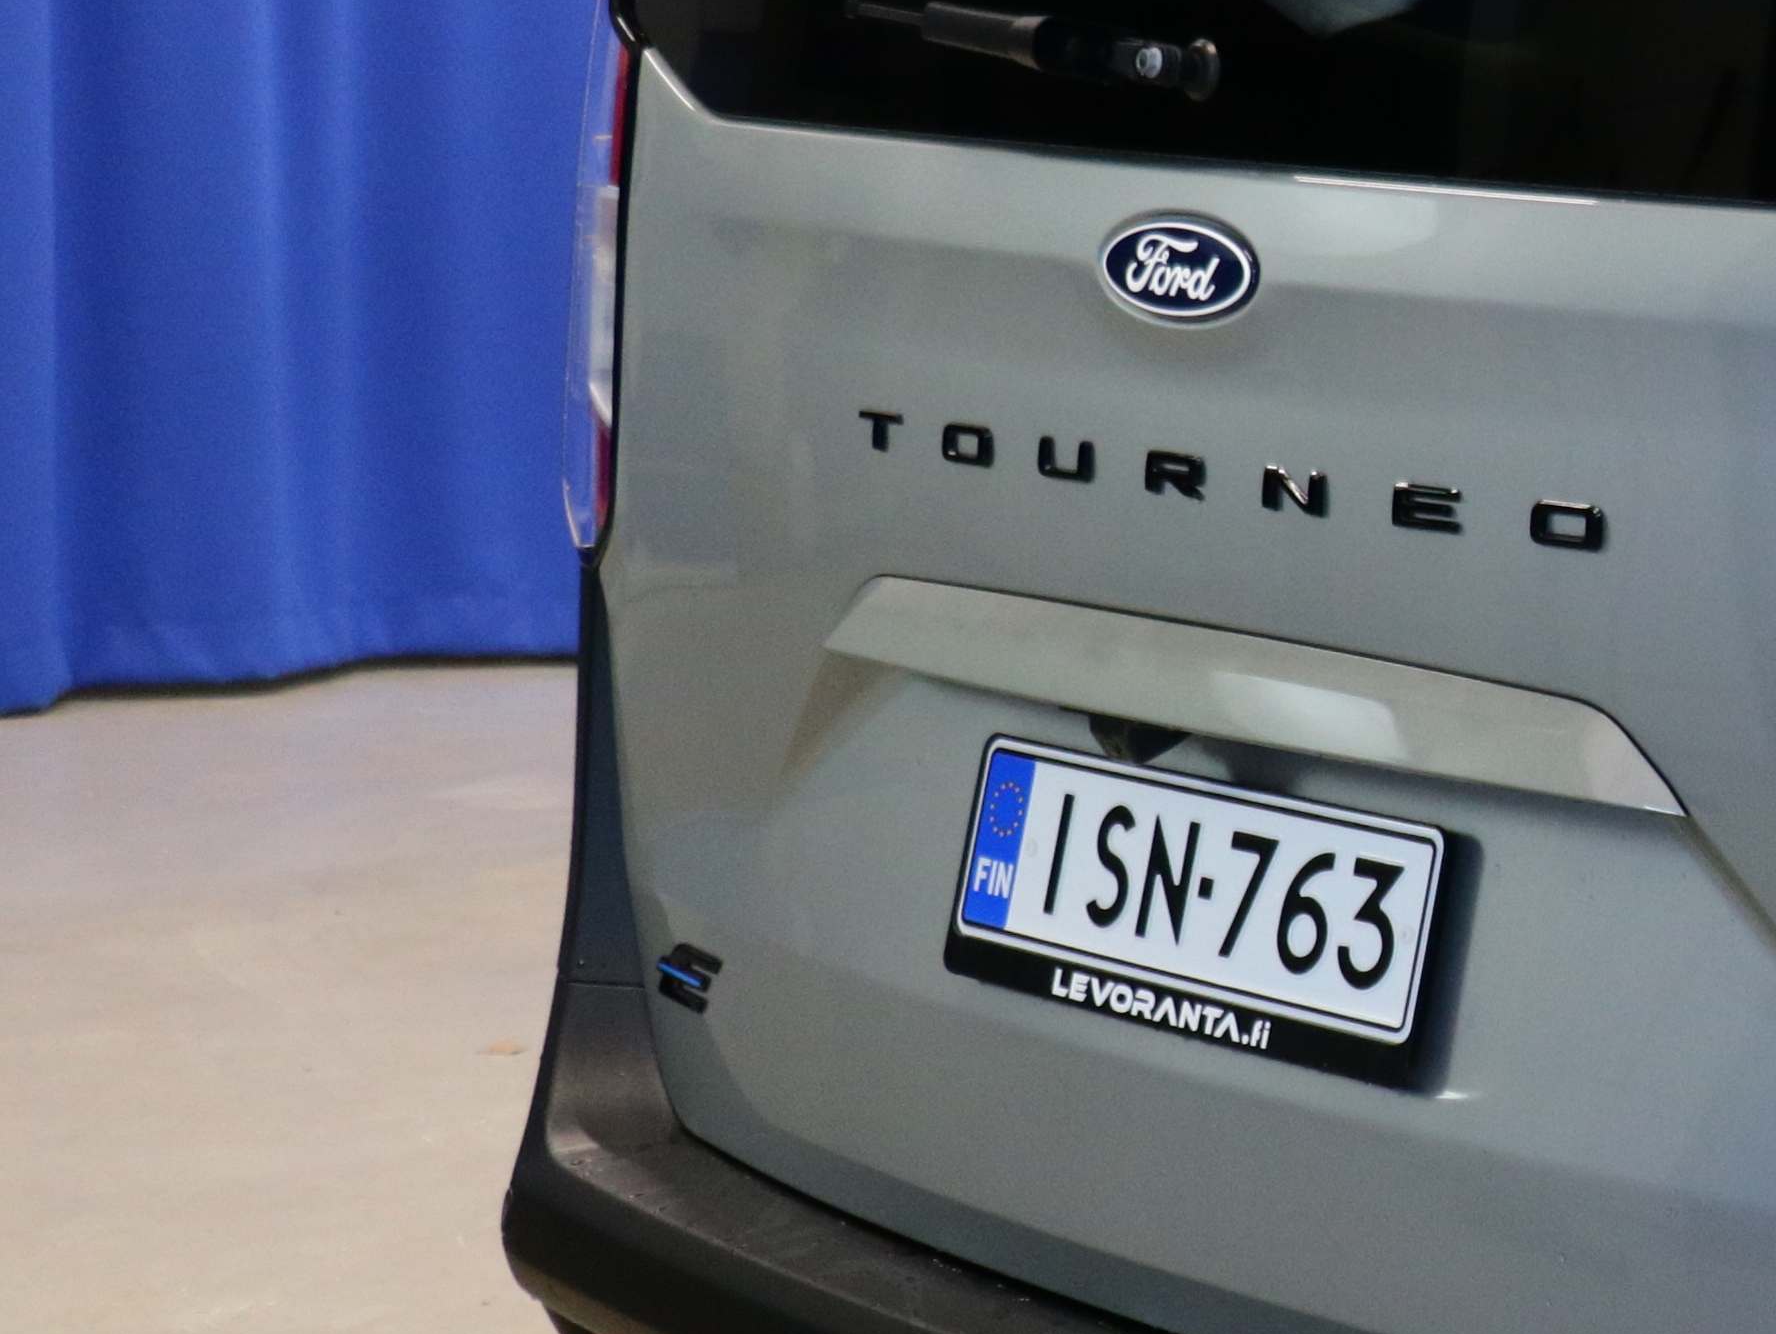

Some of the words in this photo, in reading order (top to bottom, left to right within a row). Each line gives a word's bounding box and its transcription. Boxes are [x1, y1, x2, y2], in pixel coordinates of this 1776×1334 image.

[1125, 233, 1220, 301] Ford
[858, 408, 1606, 551] TOURNEO
[972, 856, 1014, 899] FIN
[1051, 967, 1272, 1050] LEVORANTA.fi
